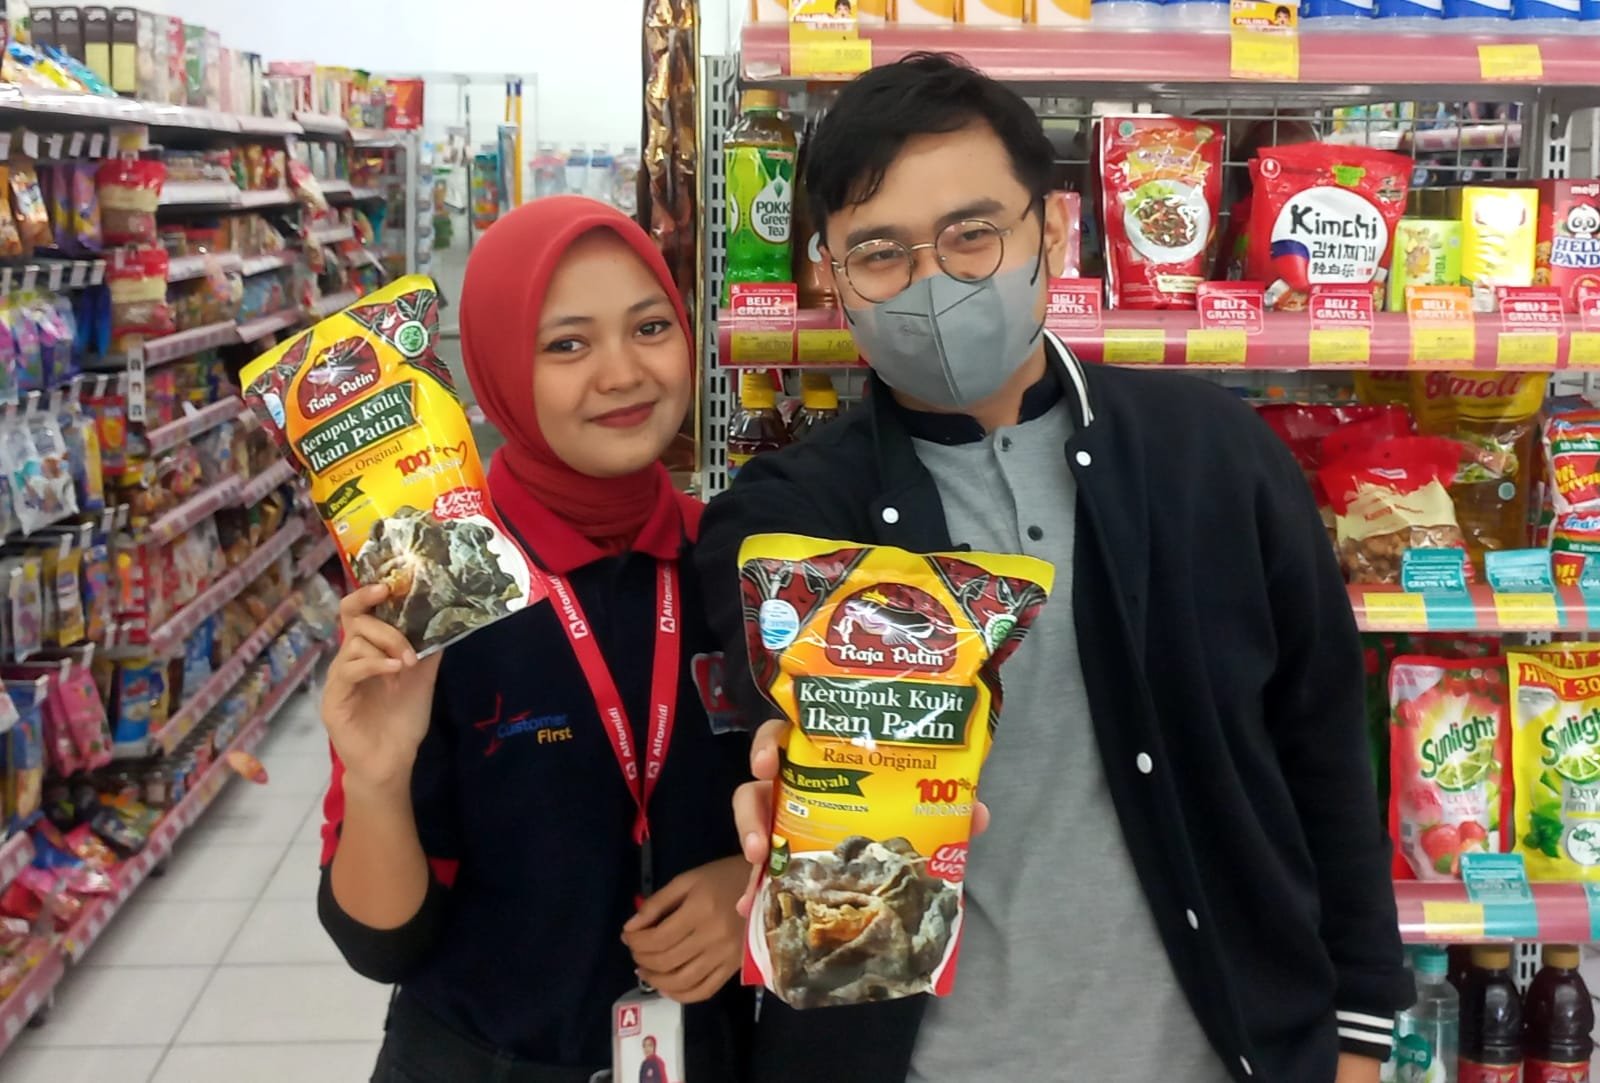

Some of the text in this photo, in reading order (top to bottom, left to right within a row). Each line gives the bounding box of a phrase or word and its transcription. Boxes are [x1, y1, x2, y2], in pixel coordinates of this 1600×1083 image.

[1290, 203, 1377, 240] Kimchi
[767, 225, 785, 237] Tea
[746, 296, 781, 306] BELI 2
[1051, 293, 1086, 304] BELI 2
[1213, 299, 1248, 309] BELI 2
[1324, 298, 1358, 309] BELI 2
[1422, 299, 1455, 310] BELI 2
[1513, 301, 1549, 311] BELI 2
[737, 306, 790, 316] GRATIS 1
[1206, 310, 1256, 320] GRATIS 1
[1316, 310, 1366, 319] GRATIS 1
[307, 373, 374, 413] Raja Patin
[301, 393, 402, 455] Kerupuk Kulit
[310, 414, 405, 471] Ikan Patin
[355, 440, 404, 471] Original
[838, 644, 944, 666] Raja Patin
[799, 682, 964, 712] Kerupuk Kulit
[653, 704, 668, 758] Alfamidi
[805, 707, 955, 739] Ikan Patin
[537, 727, 573, 744] First
[1421, 716, 1496, 778] Sunlight
[823, 747, 937, 771] Rasa Original
[797, 774, 850, 791] Renyah
